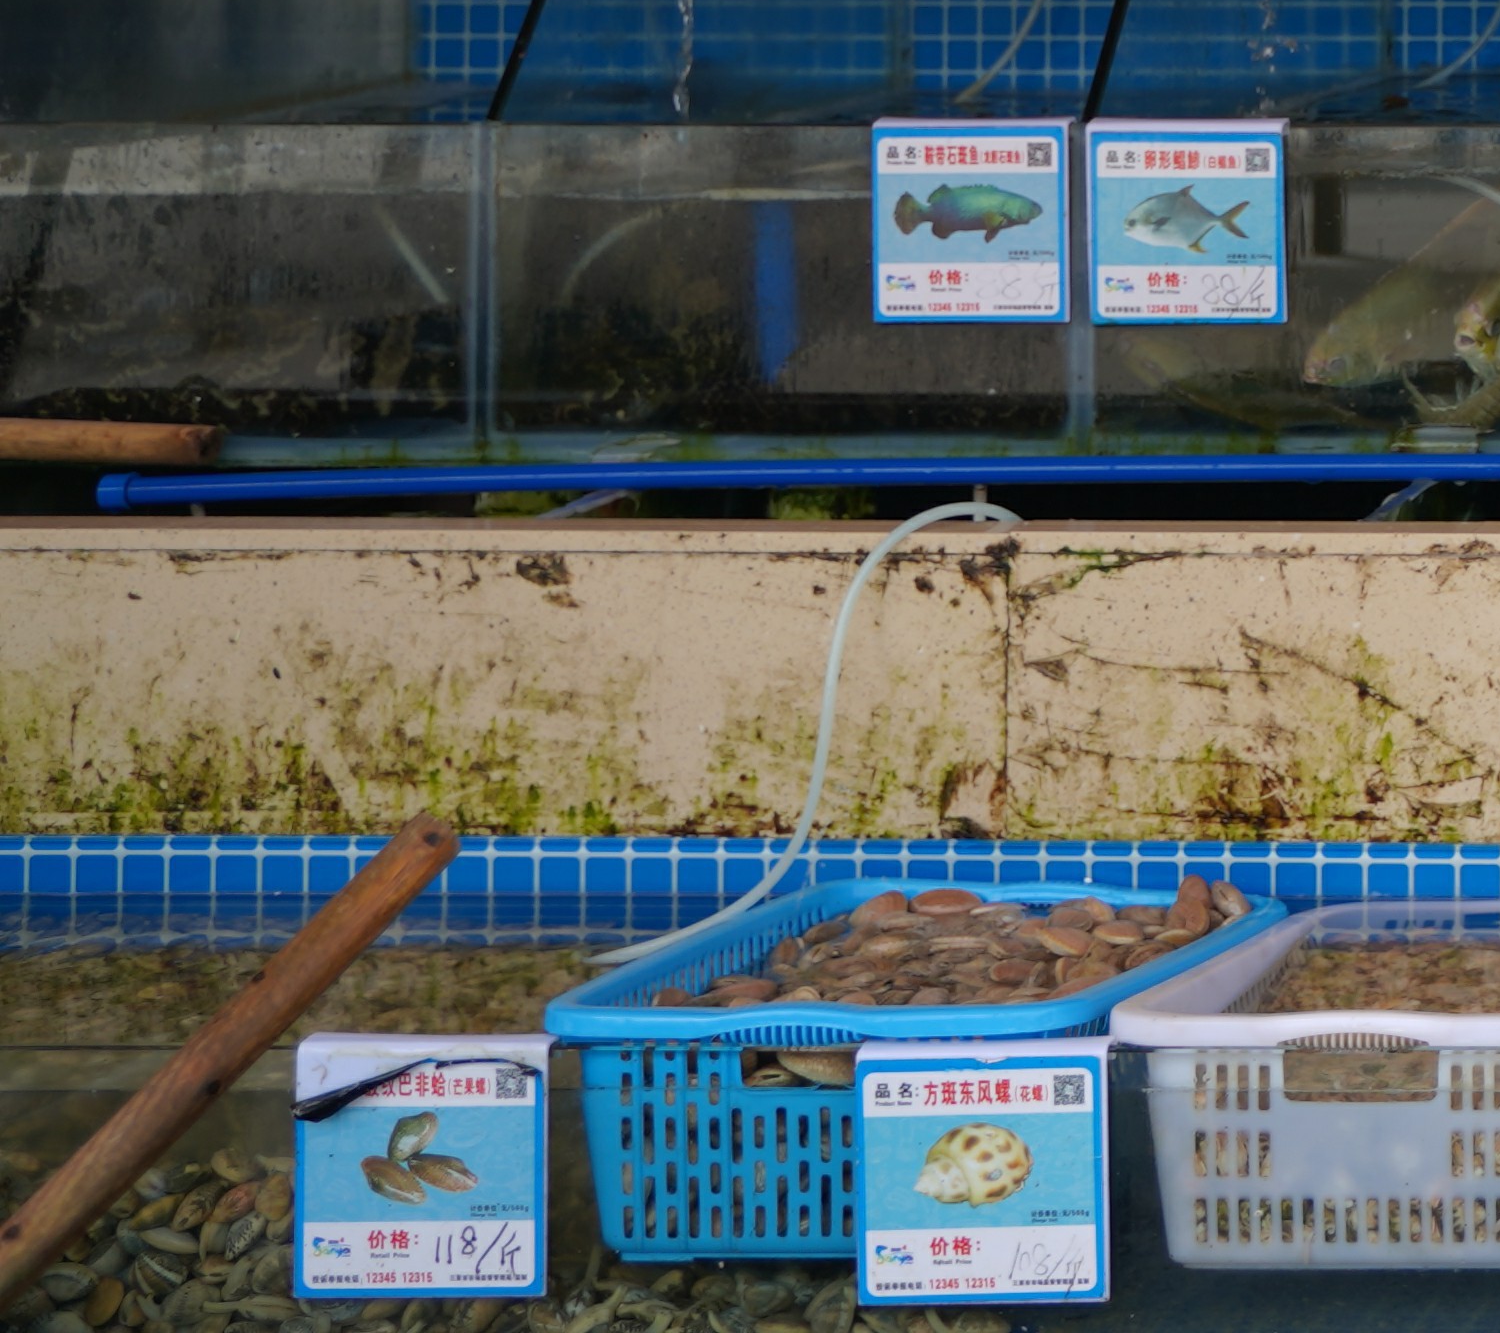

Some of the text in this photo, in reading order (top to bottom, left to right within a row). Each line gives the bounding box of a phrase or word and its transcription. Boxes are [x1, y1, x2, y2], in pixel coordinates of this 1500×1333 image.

[928, 269, 970, 286] 价格:
[1147, 271, 1188, 288] 价格:
[368, 1229, 419, 1250] 价格:
[929, 1237, 981, 1257] 价格:
